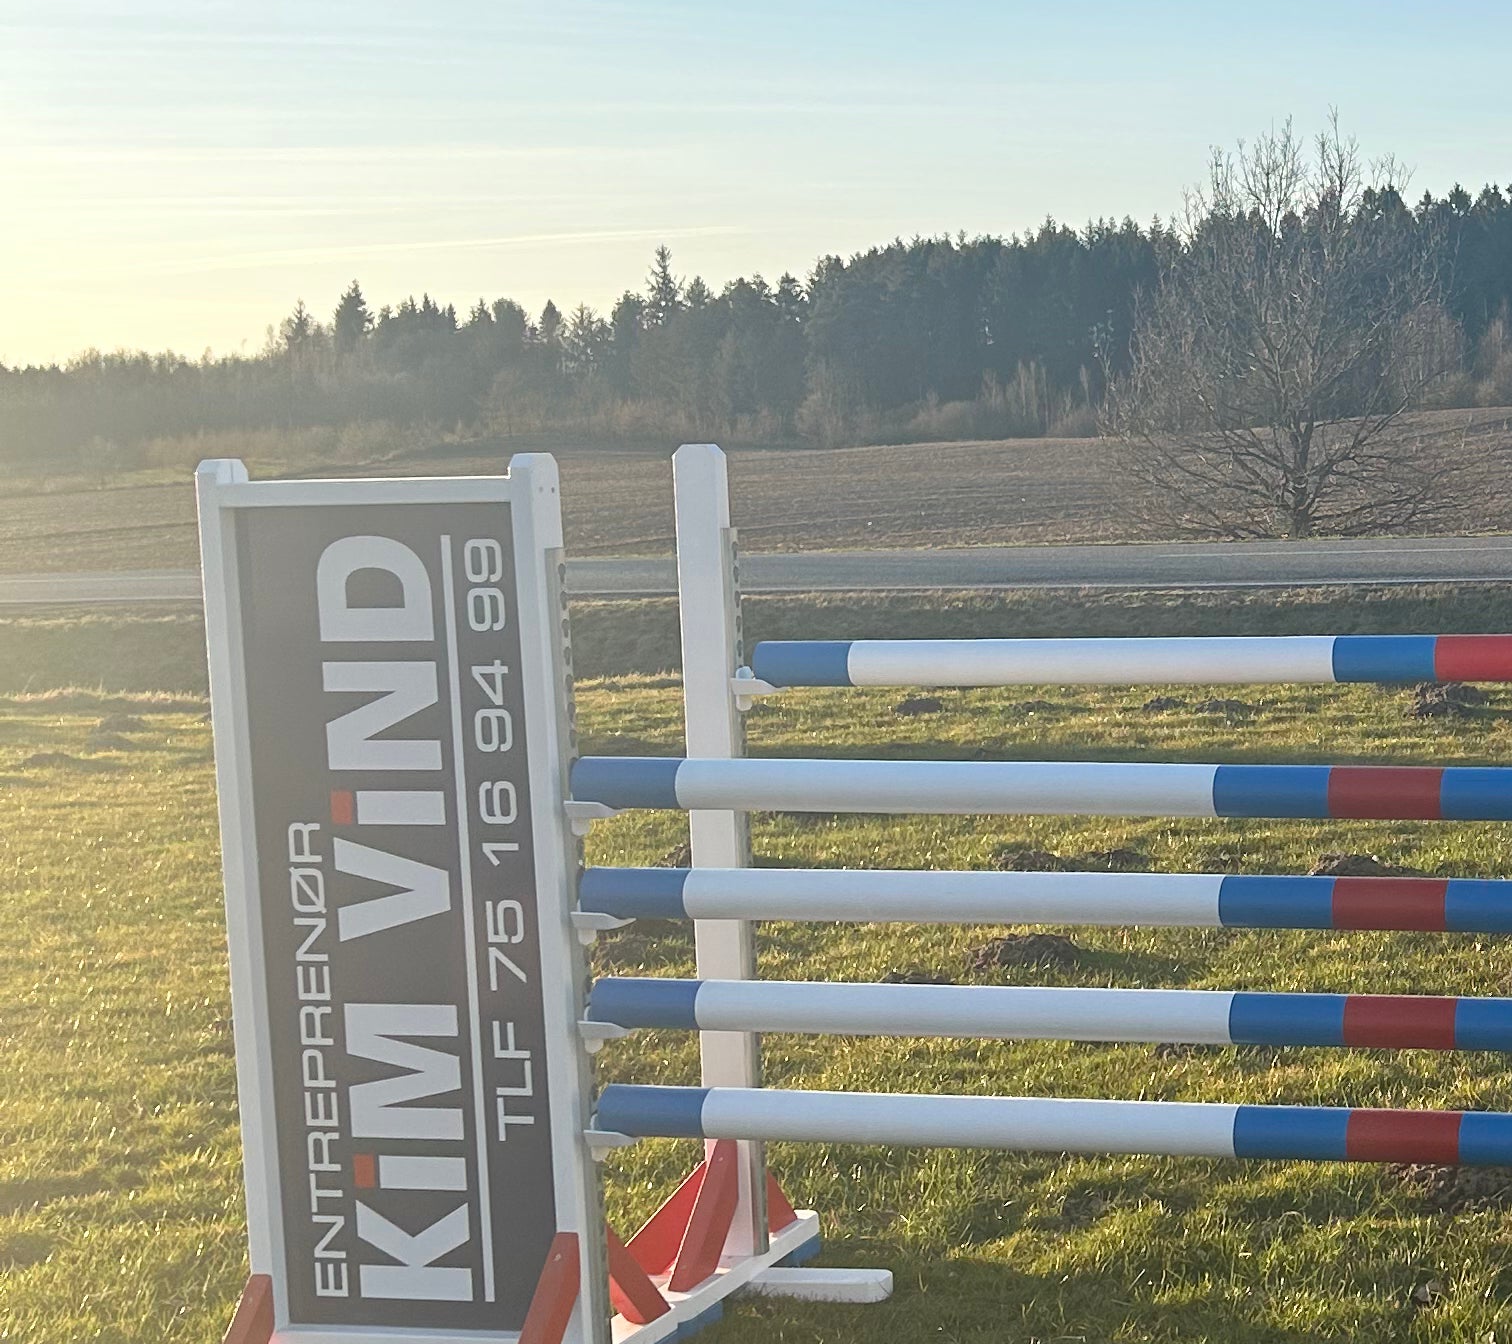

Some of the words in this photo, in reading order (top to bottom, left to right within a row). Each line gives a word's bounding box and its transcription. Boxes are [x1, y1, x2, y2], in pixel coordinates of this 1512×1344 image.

[464, 537, 506, 631] 99
[471, 660, 513, 753] 94
[479, 780, 519, 866] 16
[486, 900, 528, 991] 75
[288, 821, 348, 1297] ENTREPRENØR
[492, 1020, 534, 1141] TLF
